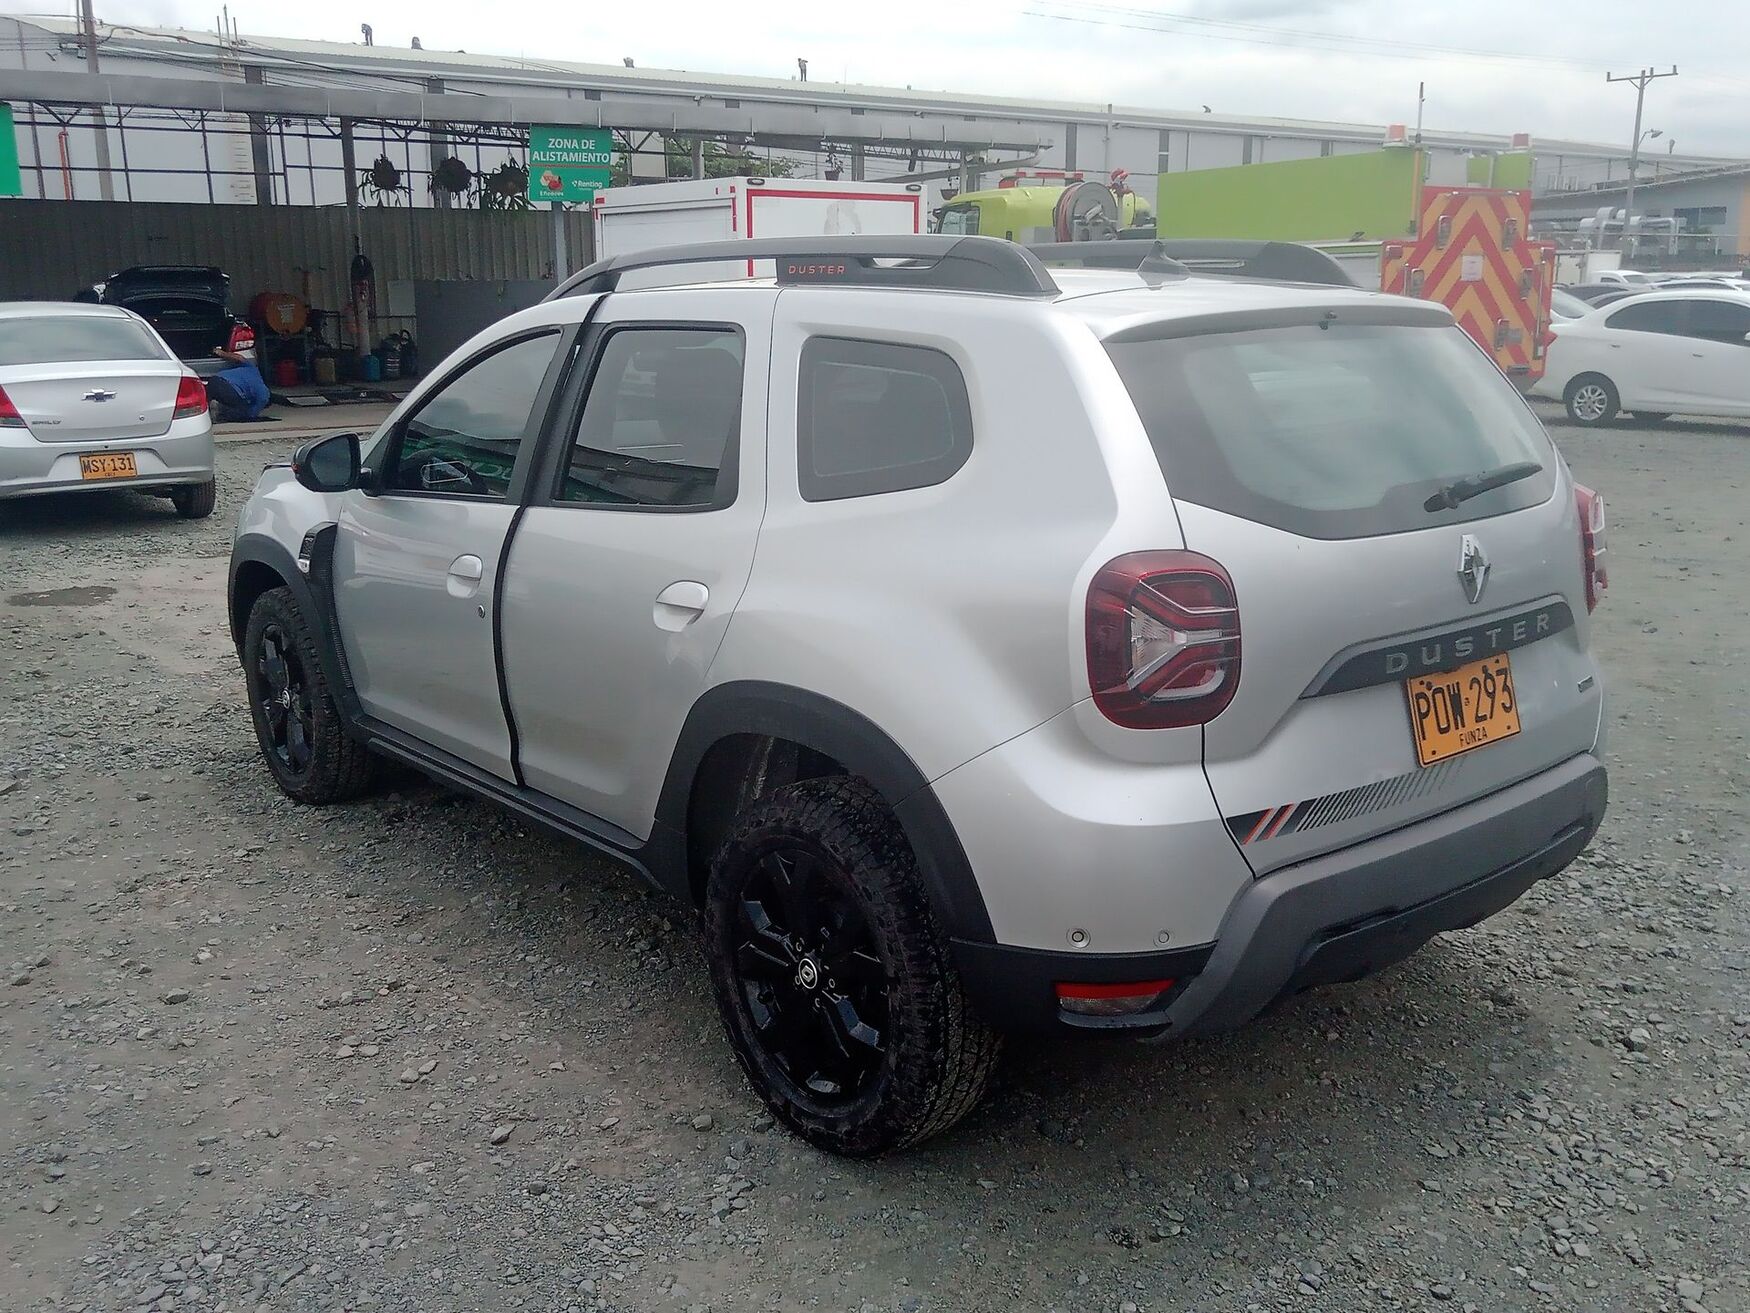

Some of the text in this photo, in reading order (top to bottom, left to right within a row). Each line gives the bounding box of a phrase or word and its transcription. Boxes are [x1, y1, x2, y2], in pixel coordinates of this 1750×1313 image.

[548, 138, 596, 150] ZONA DE
[532, 151, 610, 163] ALISTAMIENTO
[577, 180, 603, 188] Renting
[788, 265, 845, 274] DUSTER
[1386, 614, 1549, 675] DUSTER
[1458, 726, 1489, 748] FUNZA
